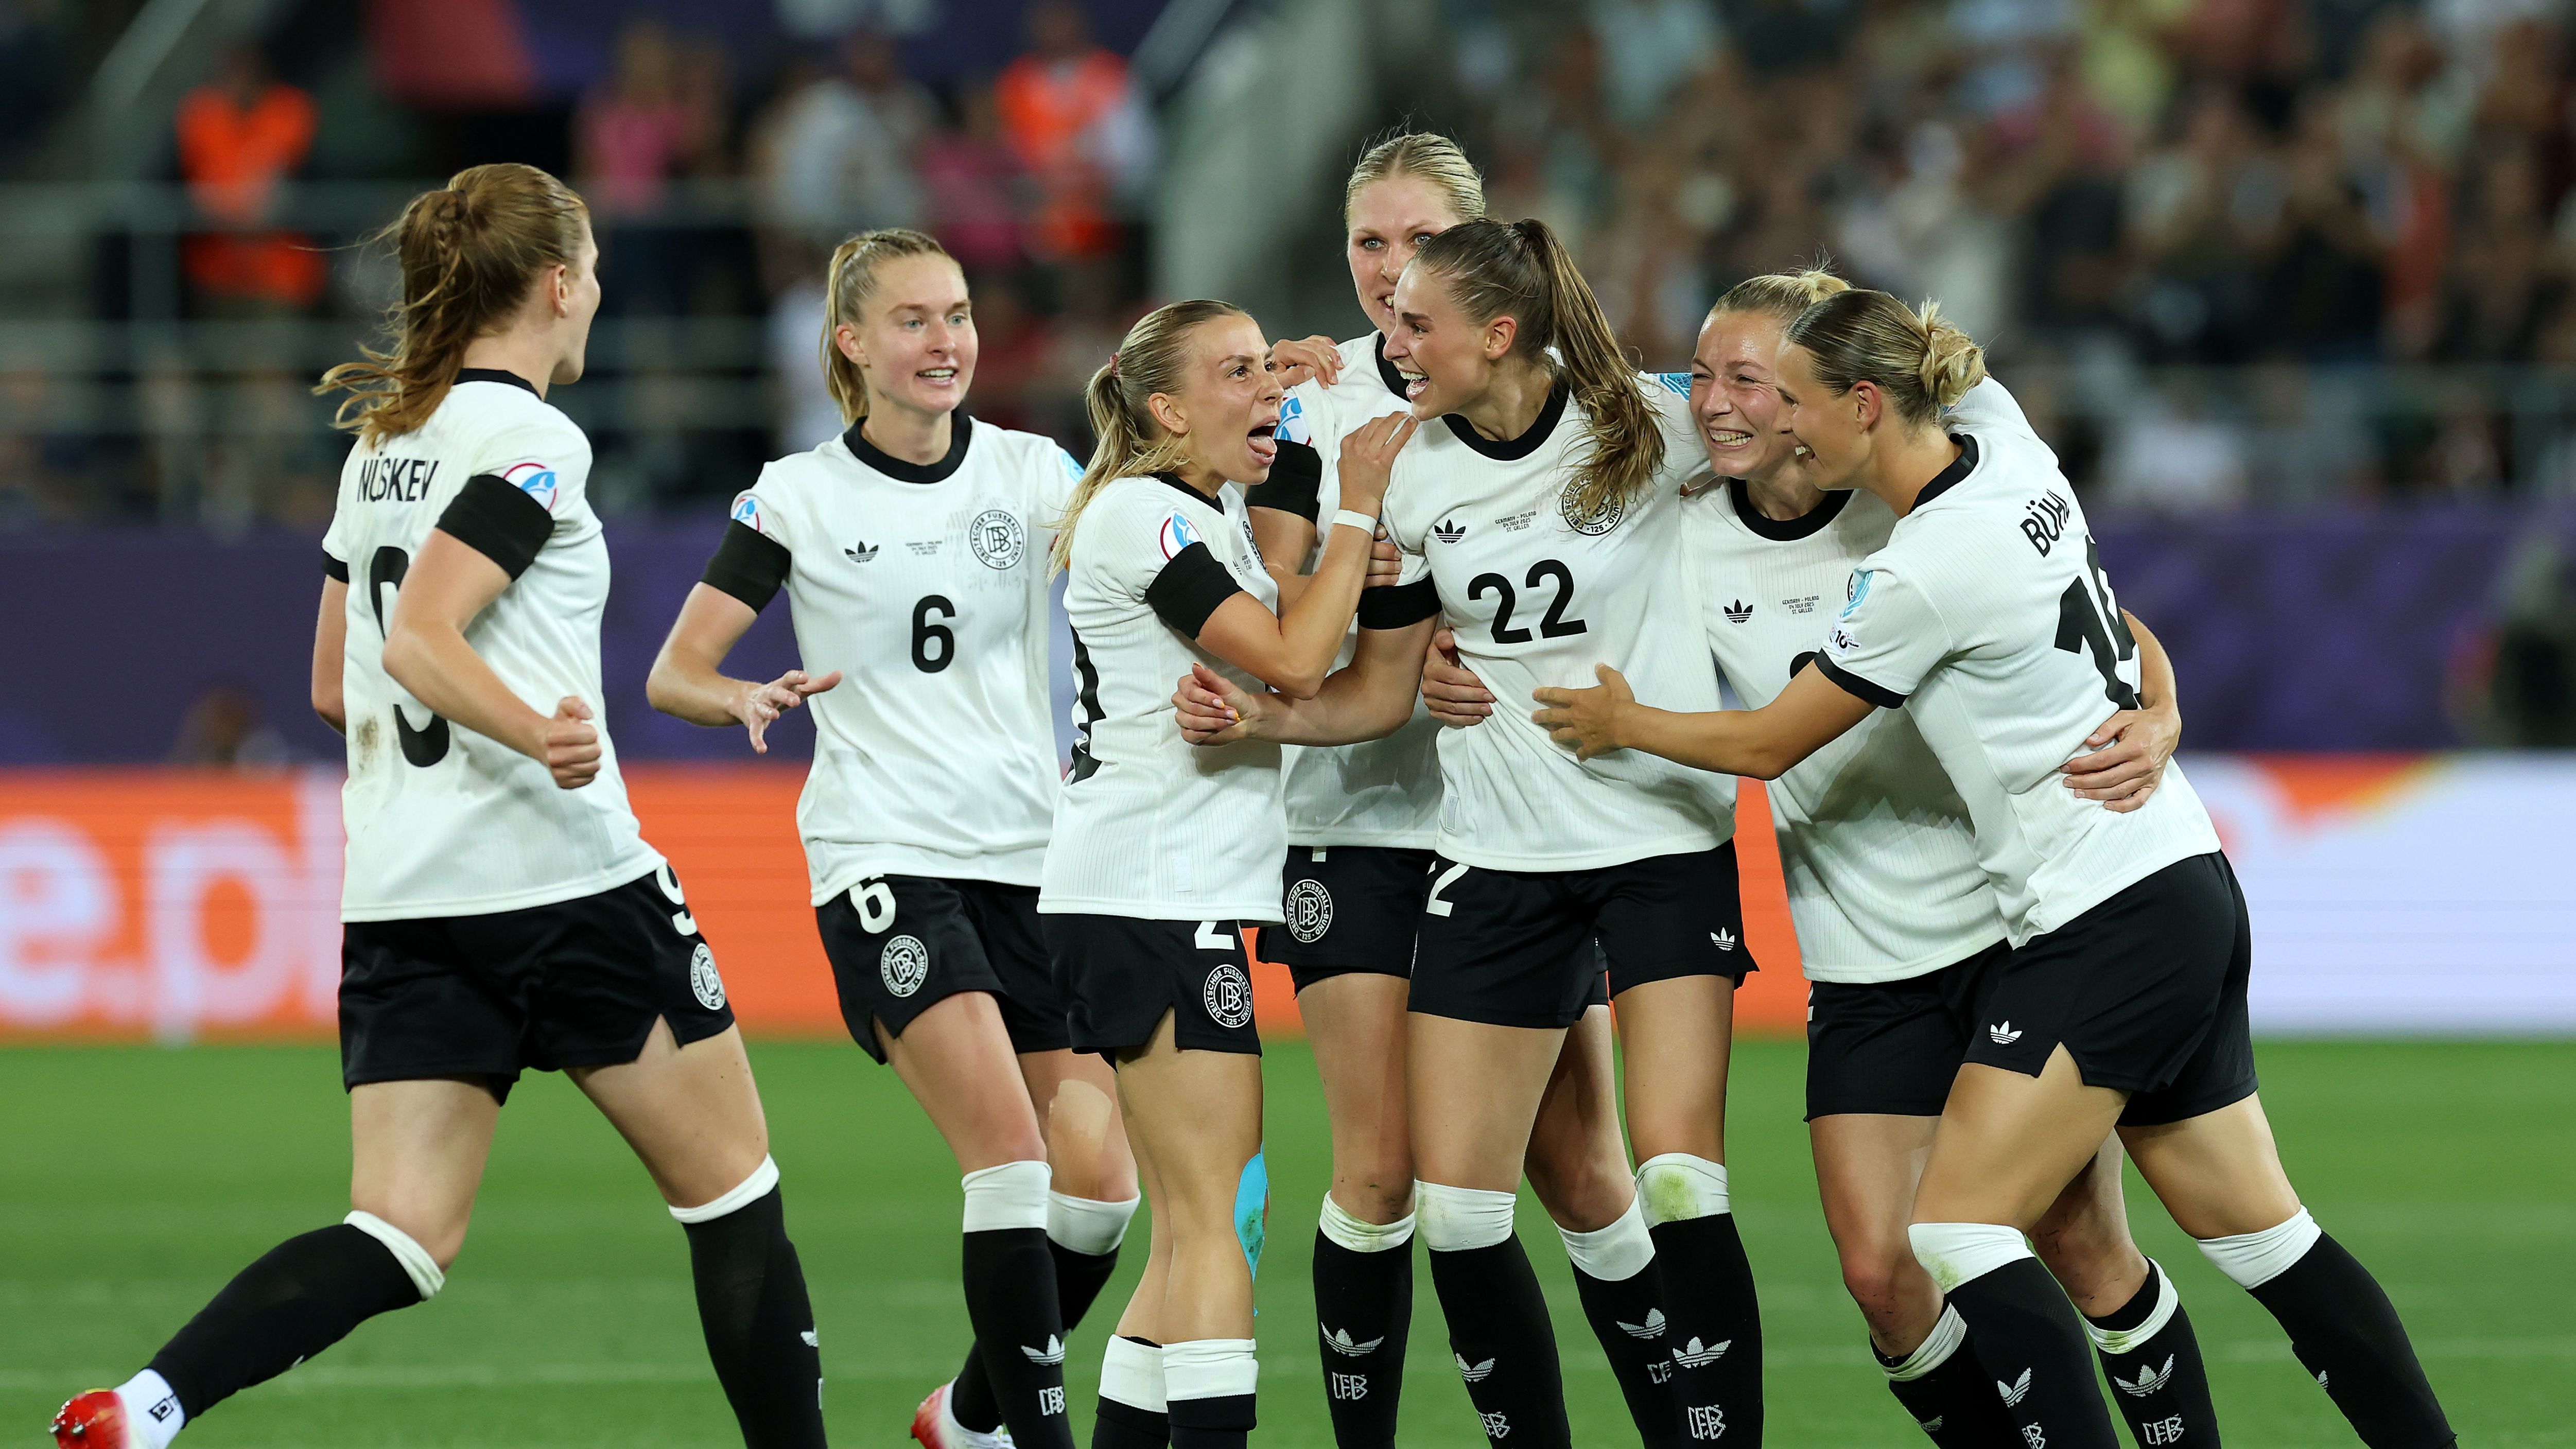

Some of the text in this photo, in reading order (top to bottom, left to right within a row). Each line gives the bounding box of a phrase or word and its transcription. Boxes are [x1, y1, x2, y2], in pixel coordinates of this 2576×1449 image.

[1495, 516, 1516, 524] GERMANY
[1467, 559, 1588, 644] 22
[911, 595, 955, 673] 6
[656, 862, 698, 936] 9
[848, 874, 897, 934] 6
[1207, 970, 1223, 1019] DEUTSCHER
[1226, 1017, 1238, 1025] 125
